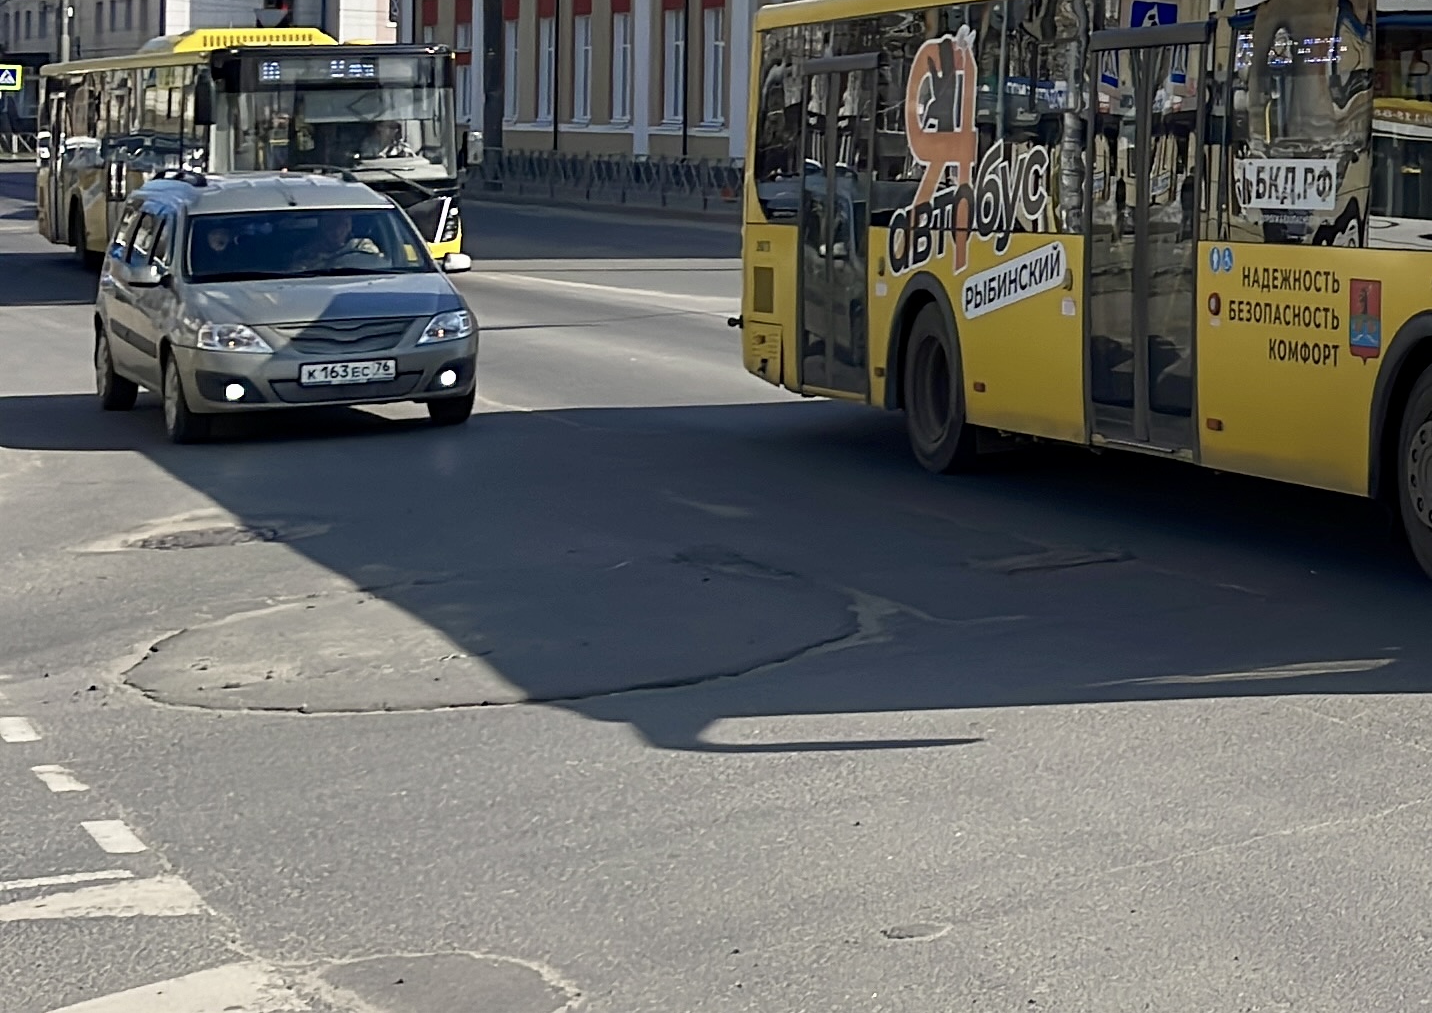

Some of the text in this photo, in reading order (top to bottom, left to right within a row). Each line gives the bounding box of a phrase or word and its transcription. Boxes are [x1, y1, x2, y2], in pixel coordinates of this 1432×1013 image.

[1255, 165, 1333, 205] БКД.РФ
[964, 243, 1061, 312] РЫБИНСКИЙ
[1241, 266, 1340, 294] НАДЕЖНОСТЬ
[1228, 299, 1340, 330] БЕЗОПАСНОСТЬ
[375, 361, 390, 372] 76
[1268, 338, 1340, 368] КОМФОРТ
